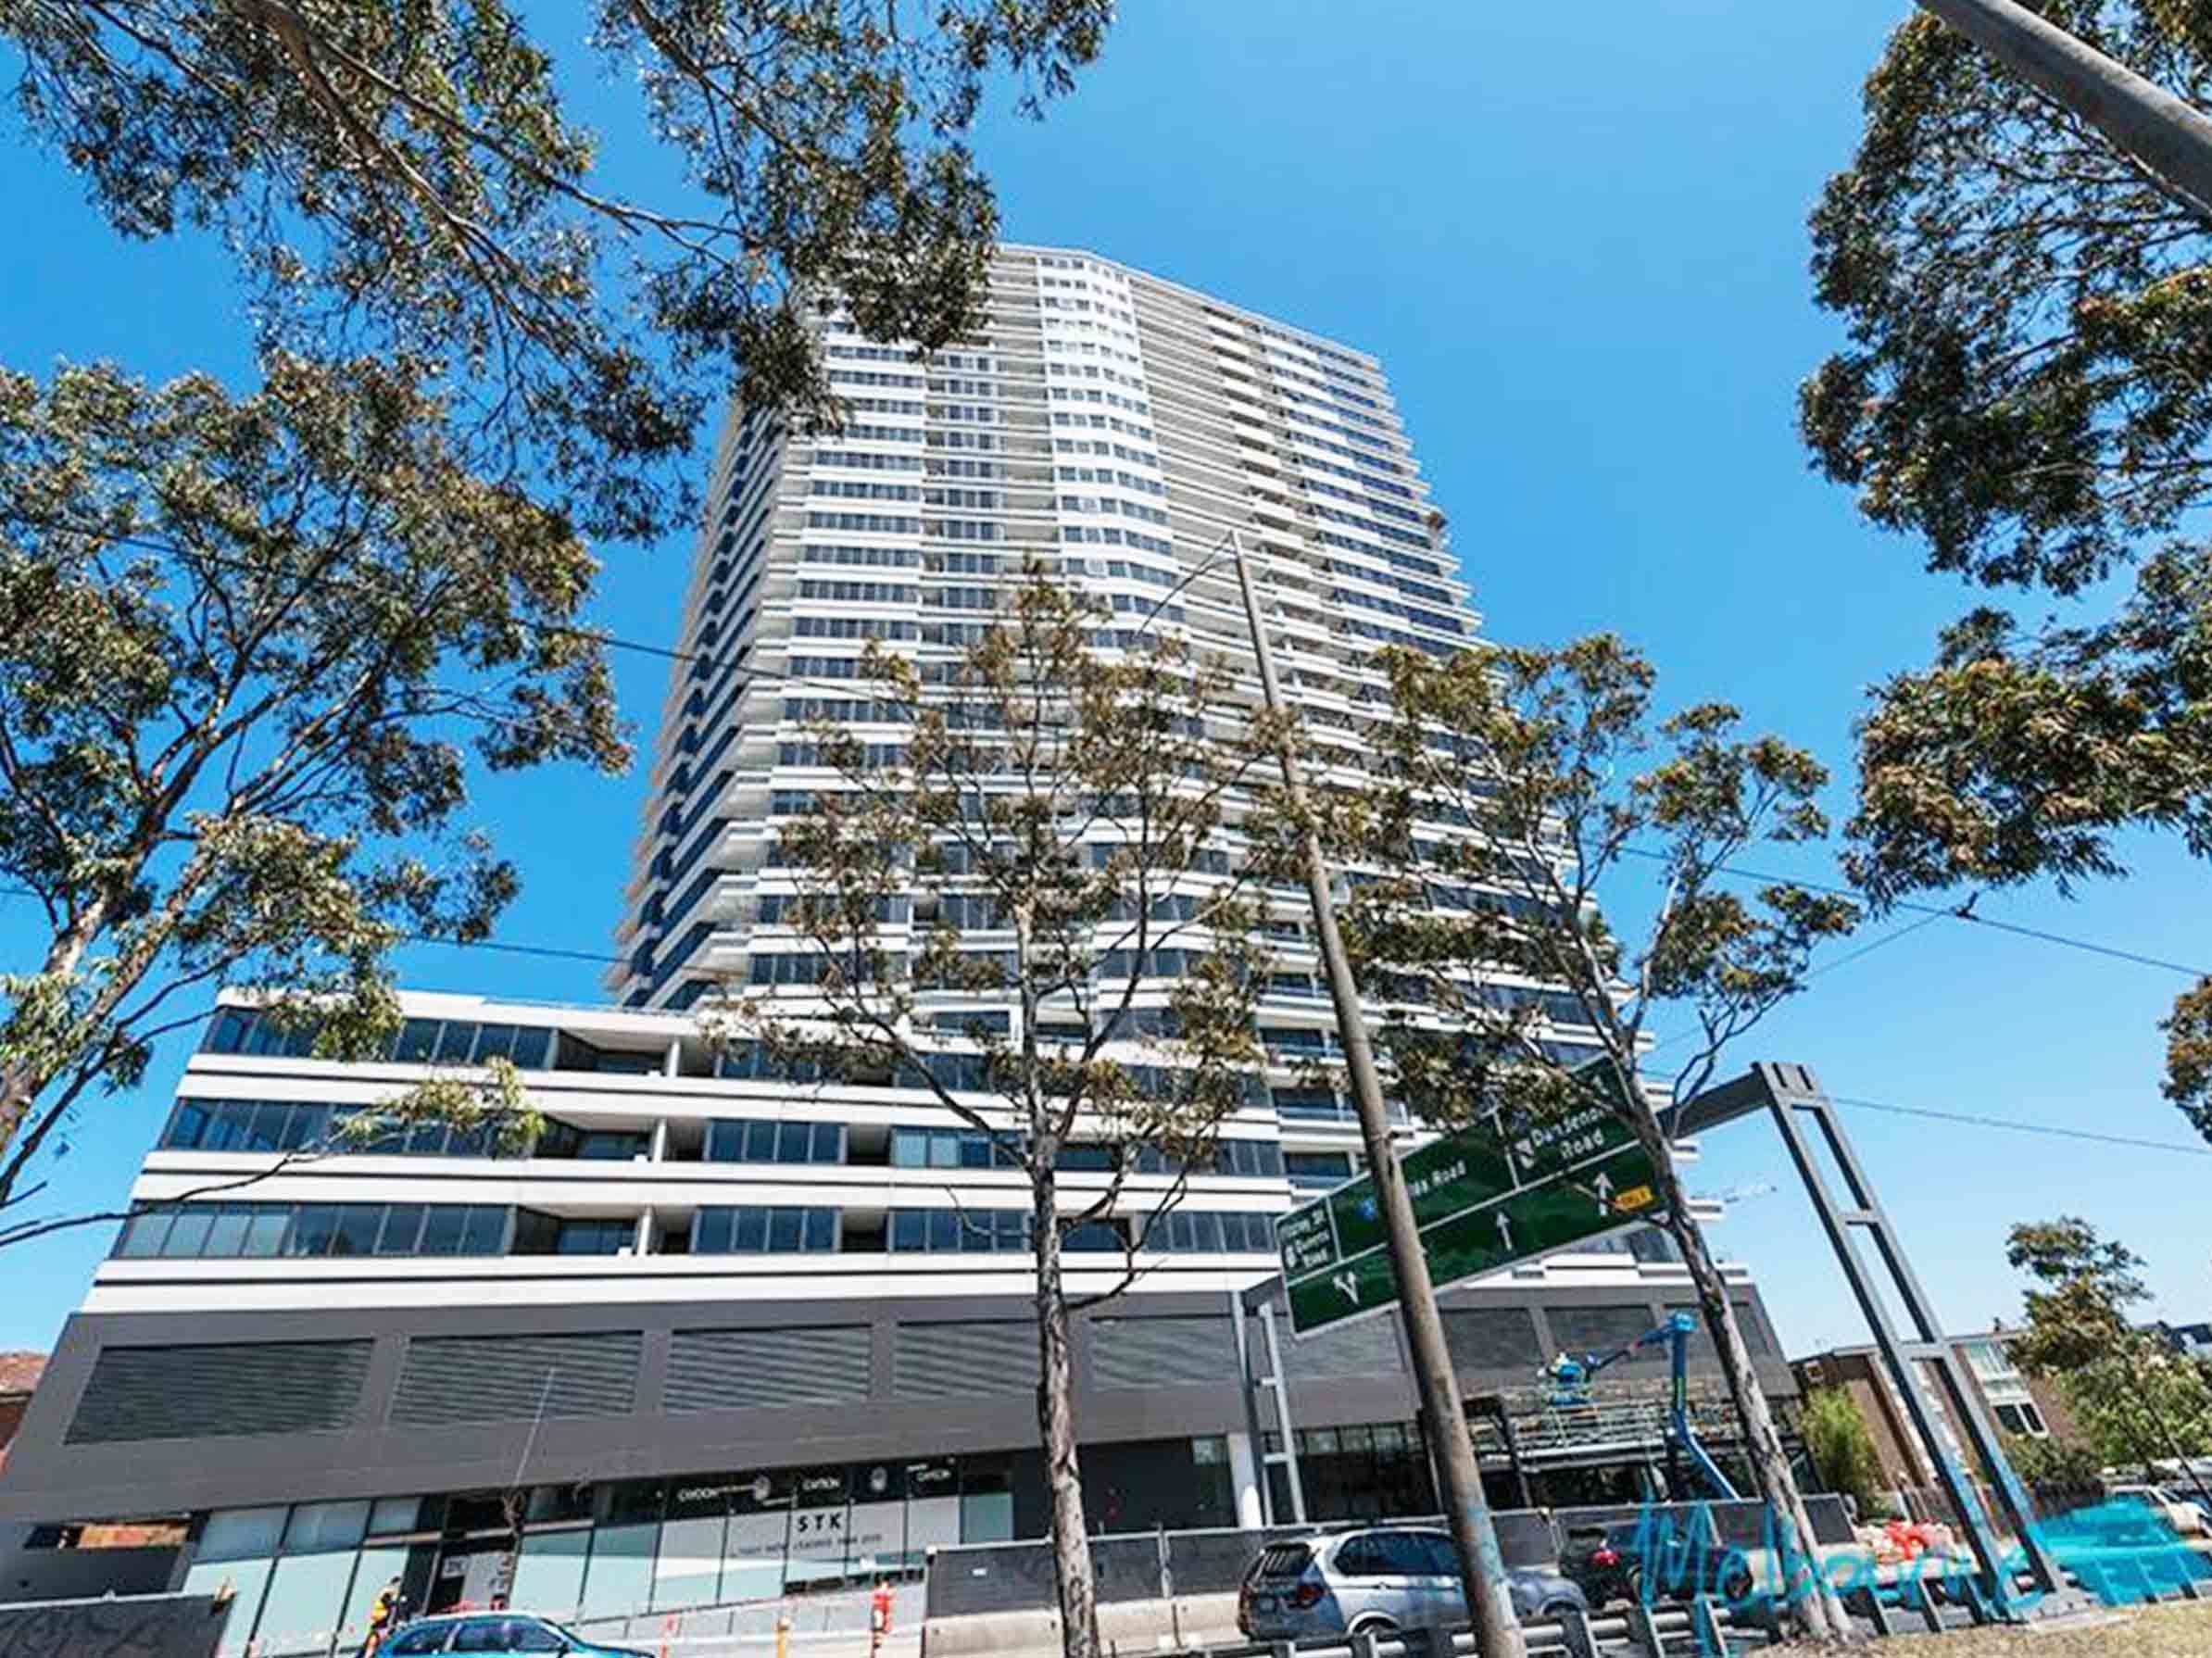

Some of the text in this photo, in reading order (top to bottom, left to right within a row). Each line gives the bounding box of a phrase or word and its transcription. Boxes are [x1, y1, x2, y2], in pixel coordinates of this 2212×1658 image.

[1560, 1127, 1604, 1159] Road
[1431, 1159, 1466, 1187] Road
[797, 1513, 842, 1533] STK
